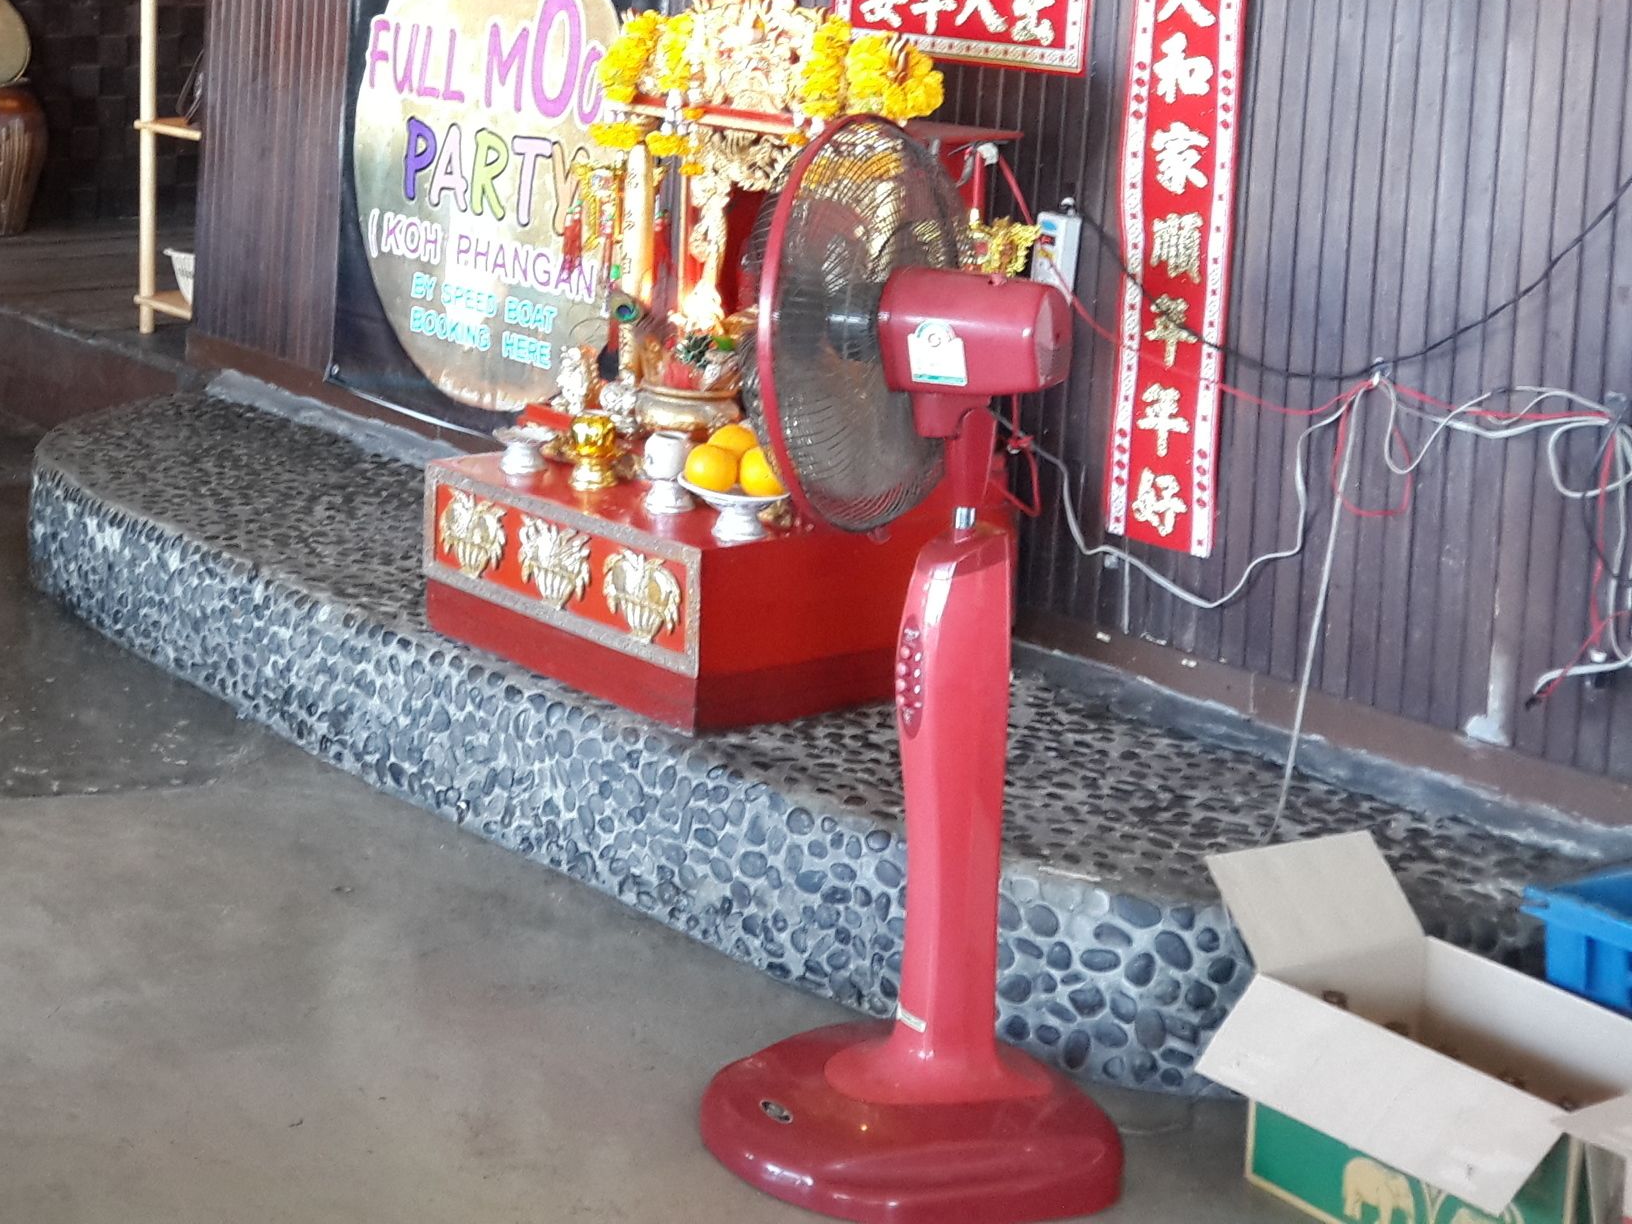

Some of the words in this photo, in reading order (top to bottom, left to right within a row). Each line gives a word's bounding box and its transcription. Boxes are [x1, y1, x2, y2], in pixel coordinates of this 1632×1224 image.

[369, 18, 466, 104] FULL
[404, 116, 590, 238] PARTY
[456, 233, 595, 300] PHANGAN
[412, 274, 436, 300] BY
[442, 284, 497, 317] SPEED
[505, 298, 558, 333] BOAT
[411, 308, 491, 350] BOOKING
[503, 333, 552, 369] HERE
